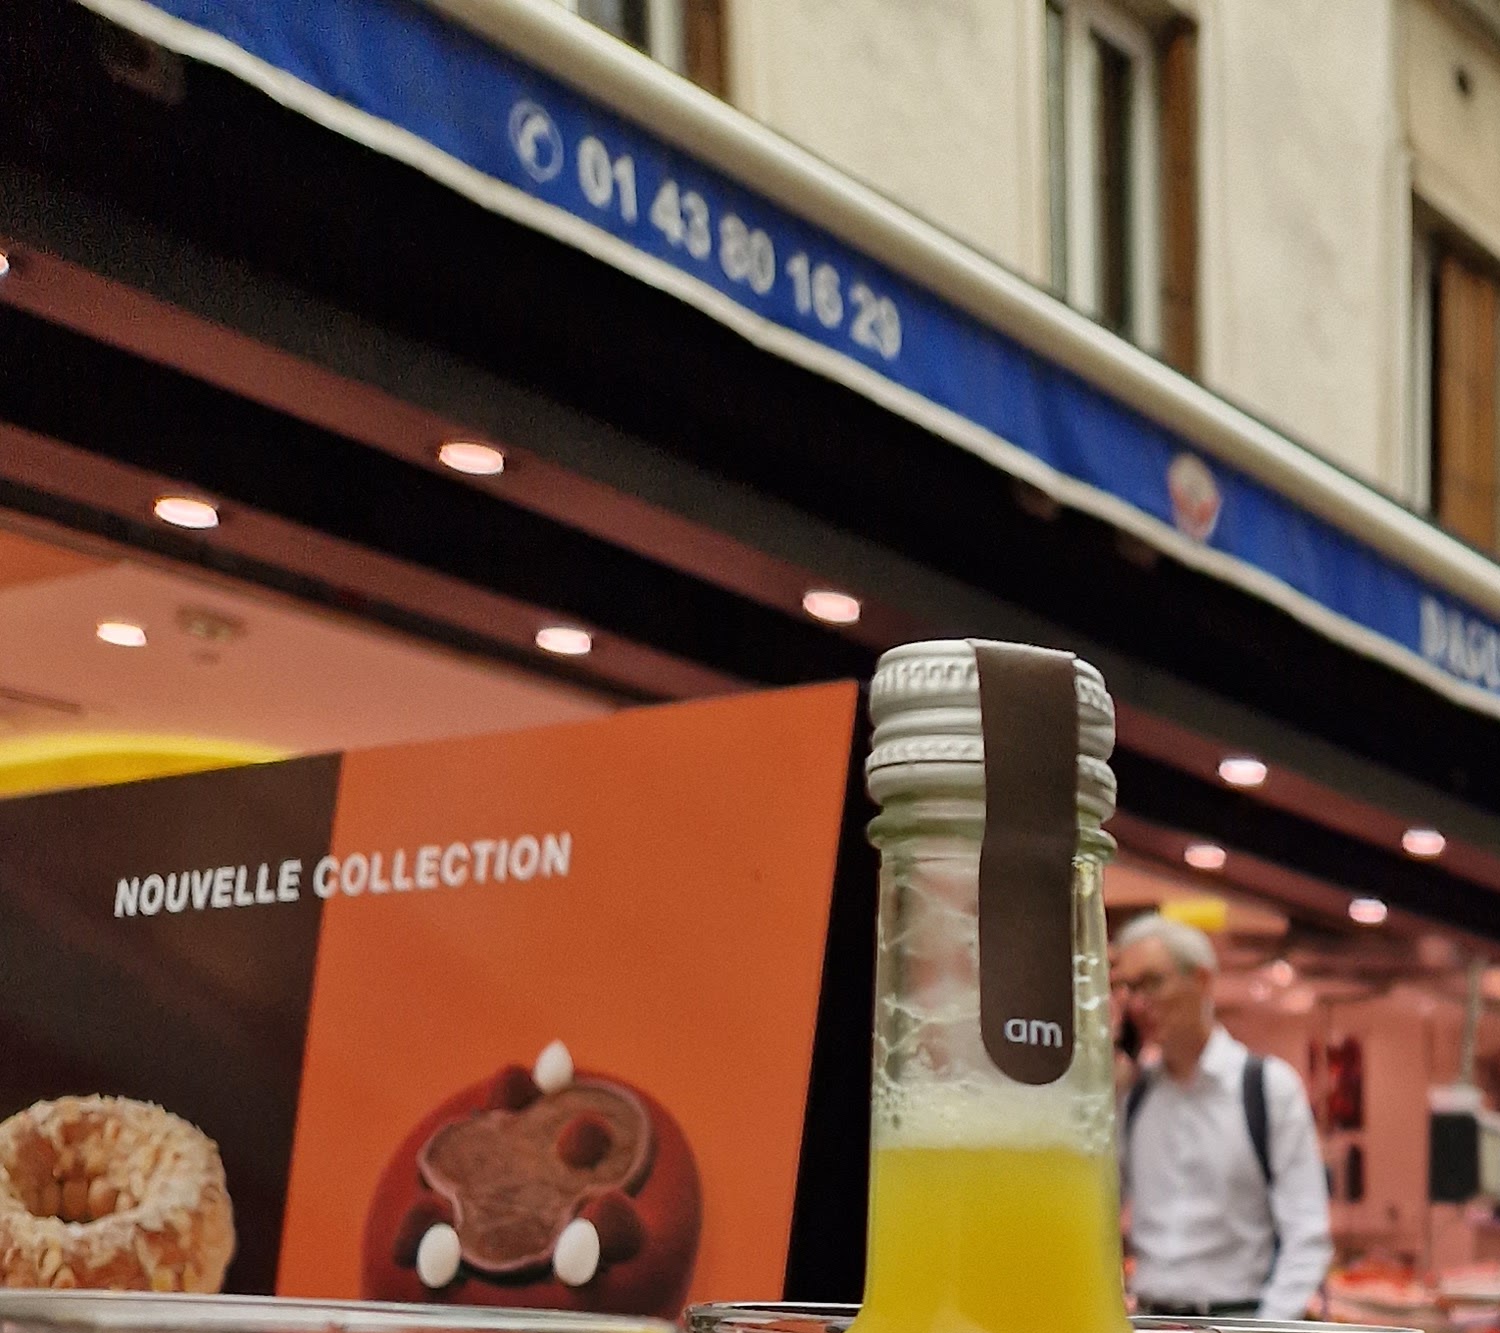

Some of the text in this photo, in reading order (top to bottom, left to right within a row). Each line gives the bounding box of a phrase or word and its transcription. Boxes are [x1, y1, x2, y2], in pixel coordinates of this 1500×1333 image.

[577, 136, 637, 225] 01
[651, 180, 711, 261] 43
[719, 213, 775, 295] 80
[787, 250, 843, 329] 16
[113, 832, 572, 919] NOUVELLE COLLECTION
[1004, 1018, 1063, 1048] am
